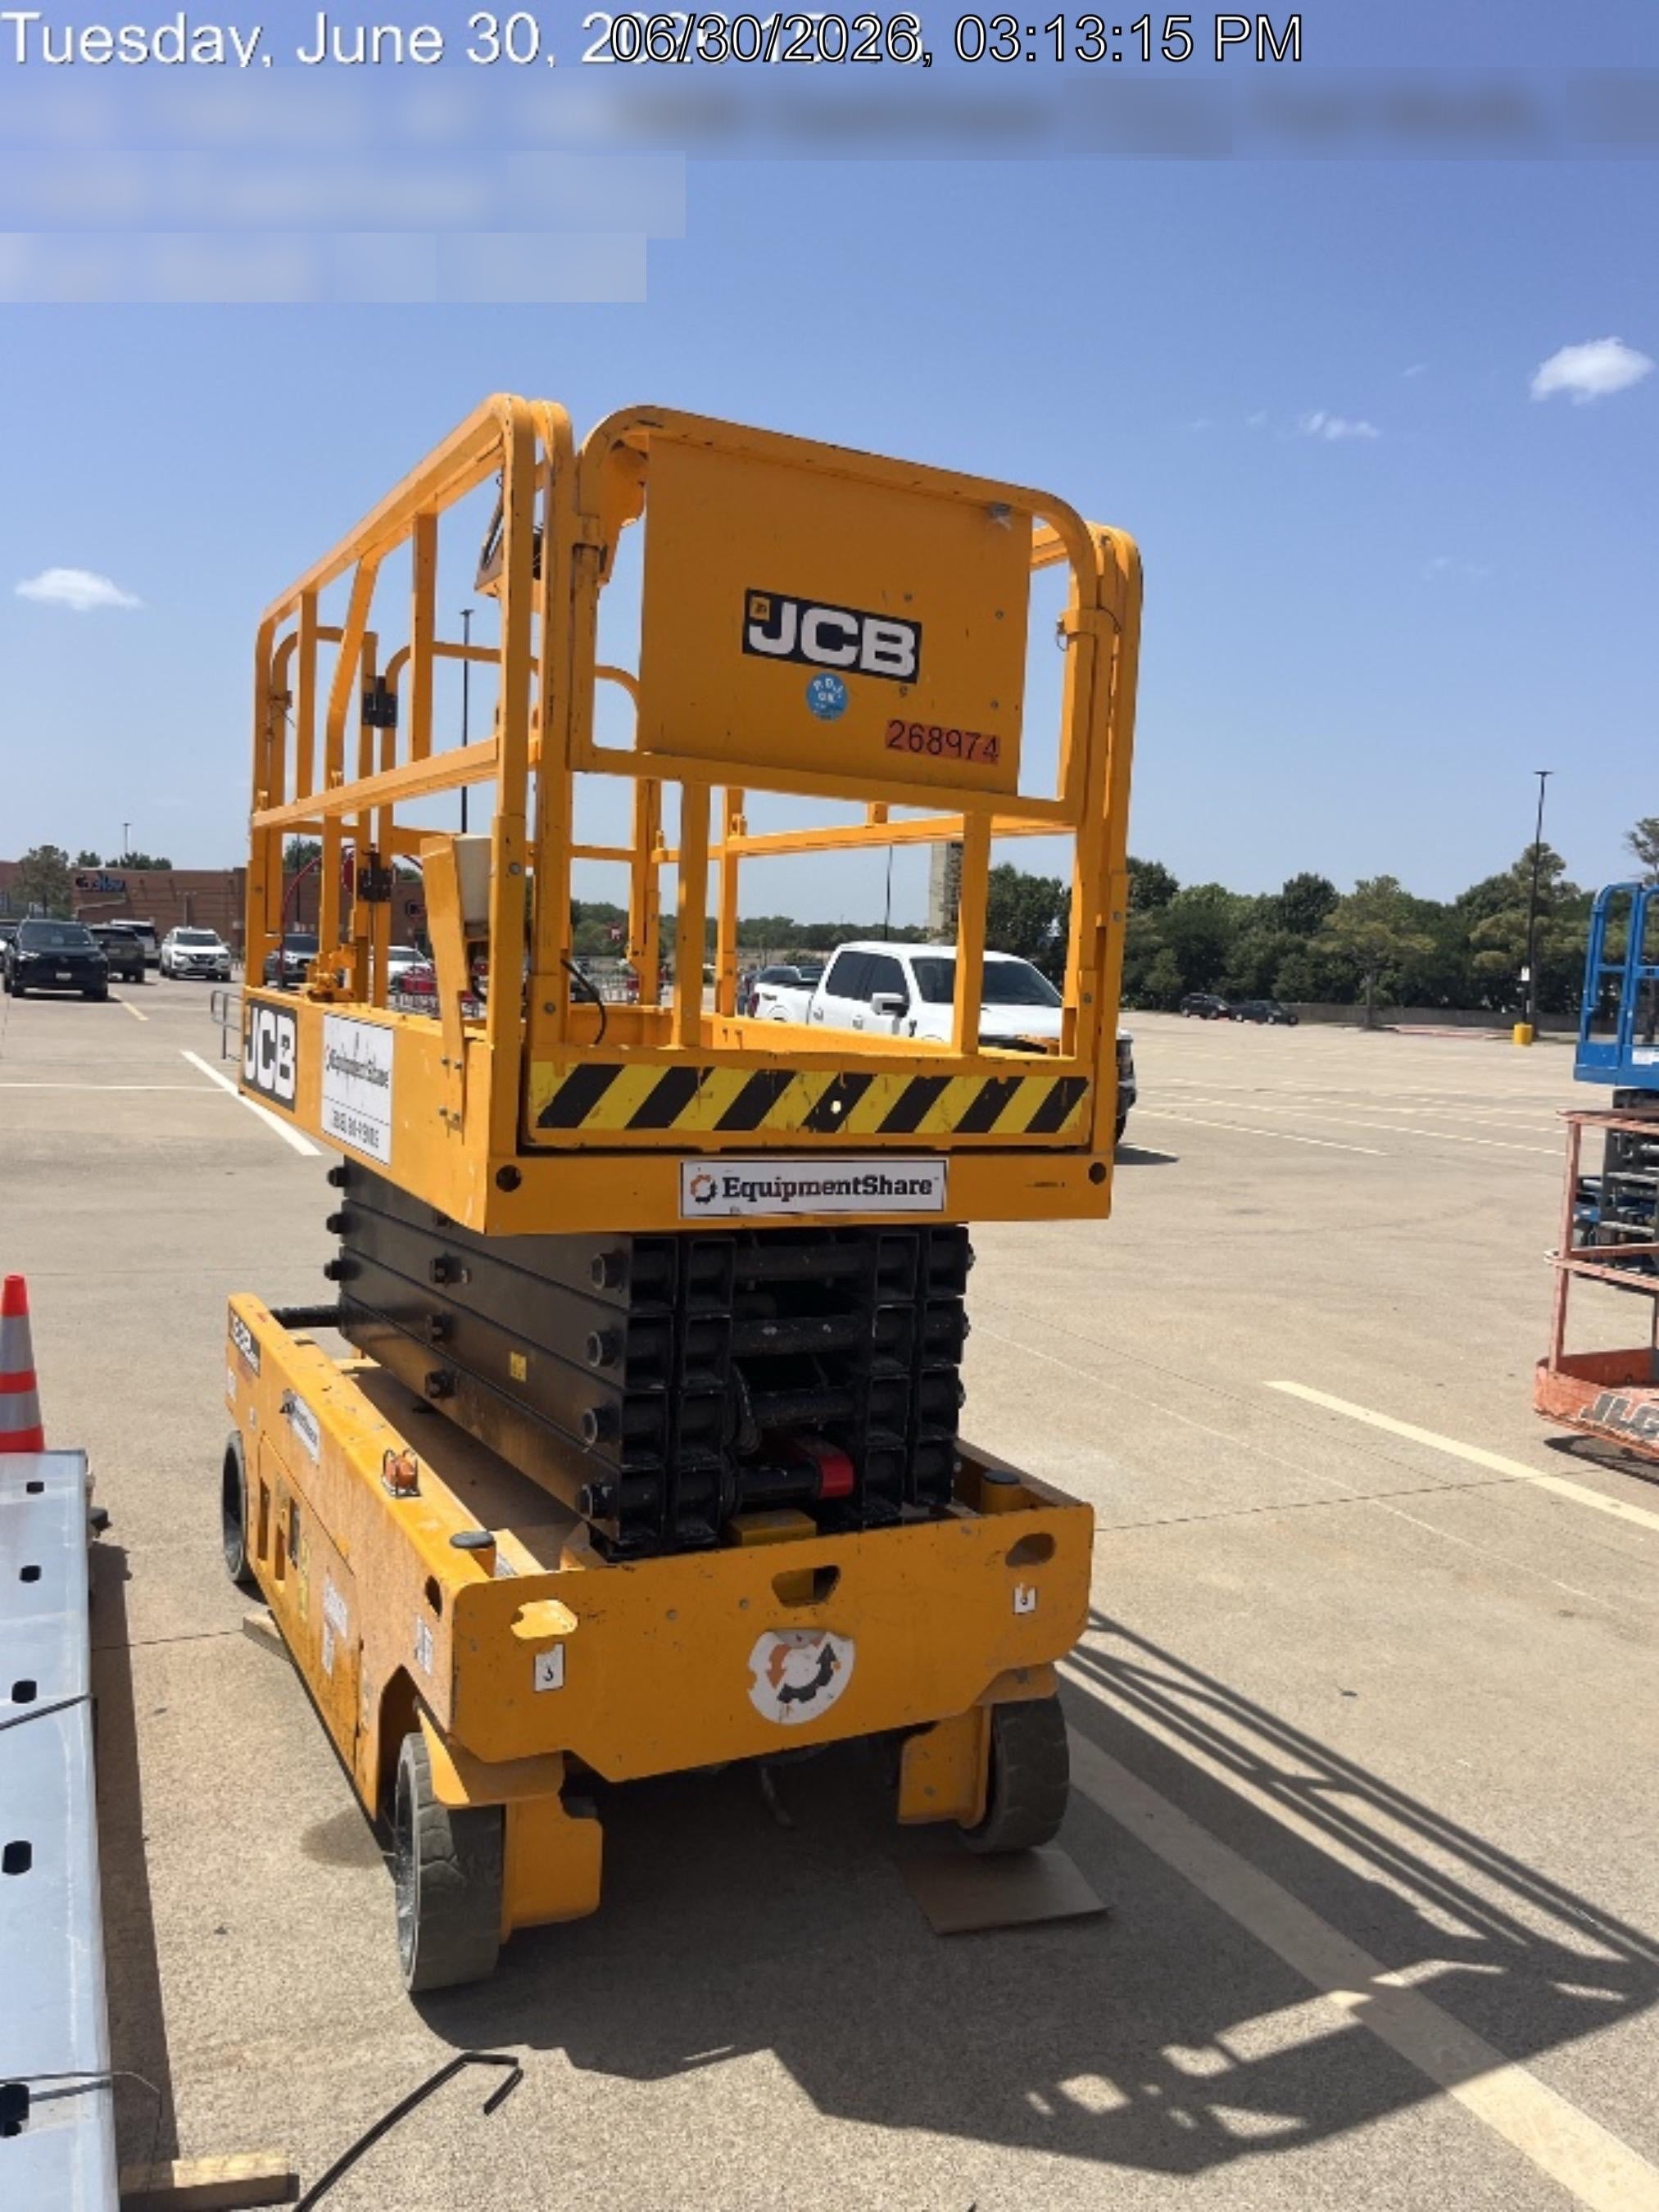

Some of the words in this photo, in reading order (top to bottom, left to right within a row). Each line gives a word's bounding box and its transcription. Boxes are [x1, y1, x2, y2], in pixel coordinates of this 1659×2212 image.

[747, 601, 916, 678] JCB
[886, 718, 999, 763] 268974
[244, 1006, 296, 1100] JCB
[722, 1174, 933, 1202] EquipmentShare
